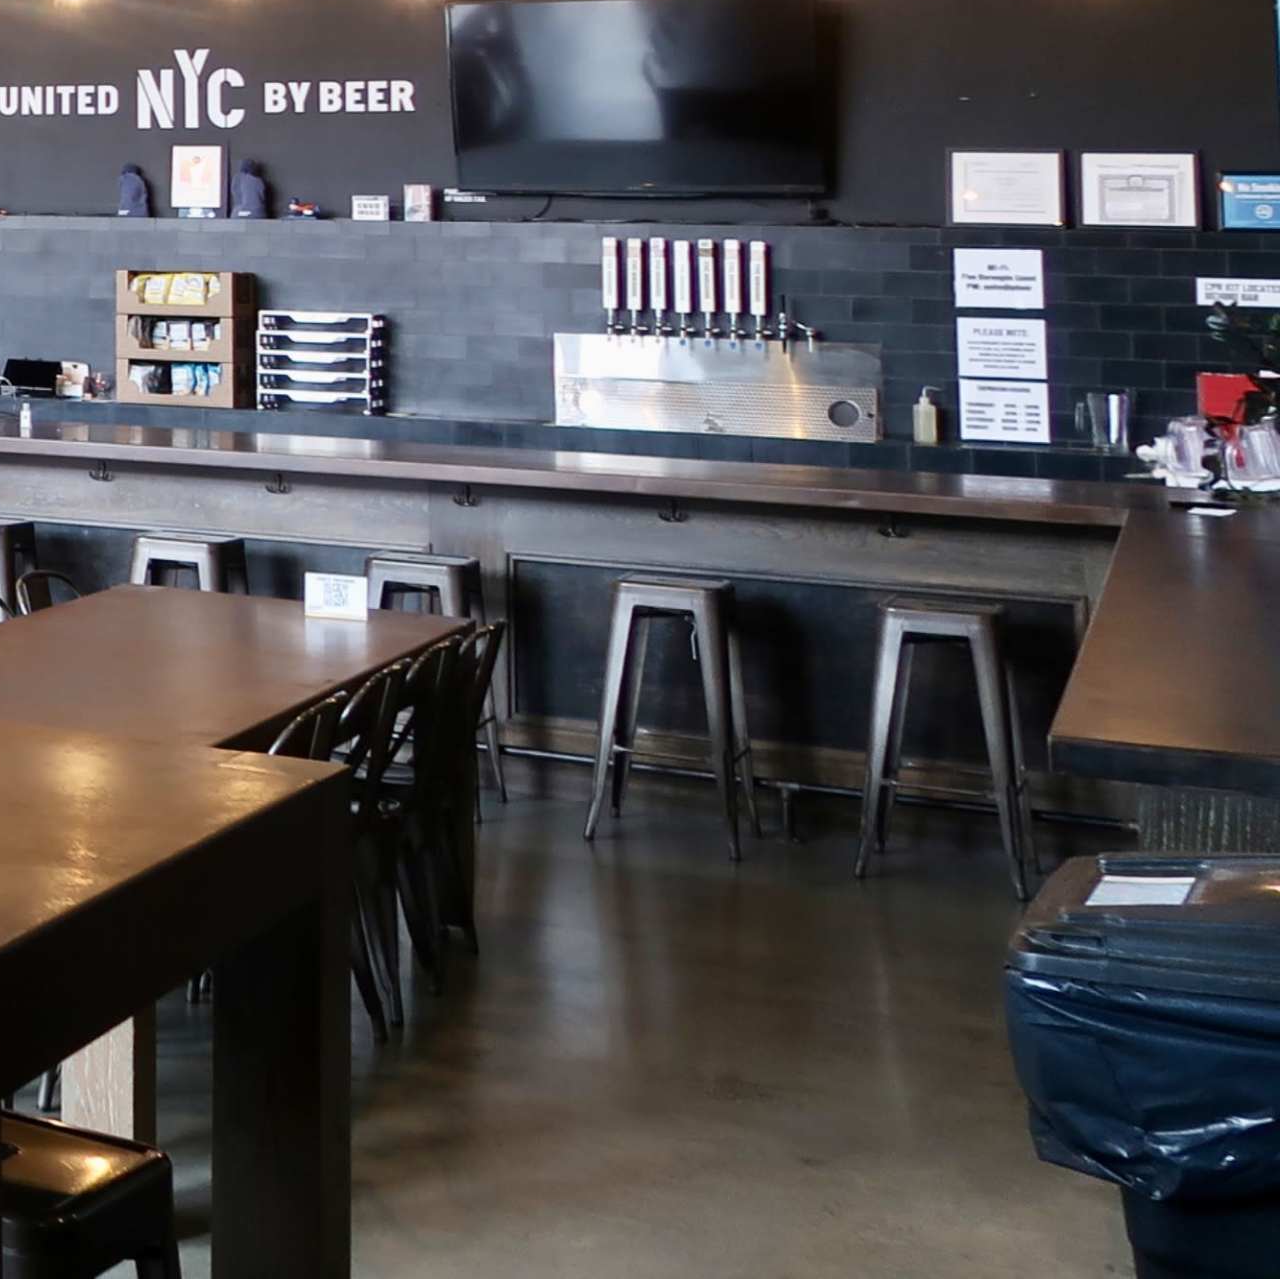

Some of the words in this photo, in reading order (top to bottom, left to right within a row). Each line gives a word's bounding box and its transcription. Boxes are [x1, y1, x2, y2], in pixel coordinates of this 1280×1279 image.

[137, 49, 245, 129] NYC
[264, 82, 311, 114] BY
[320, 80, 416, 113] BEER
